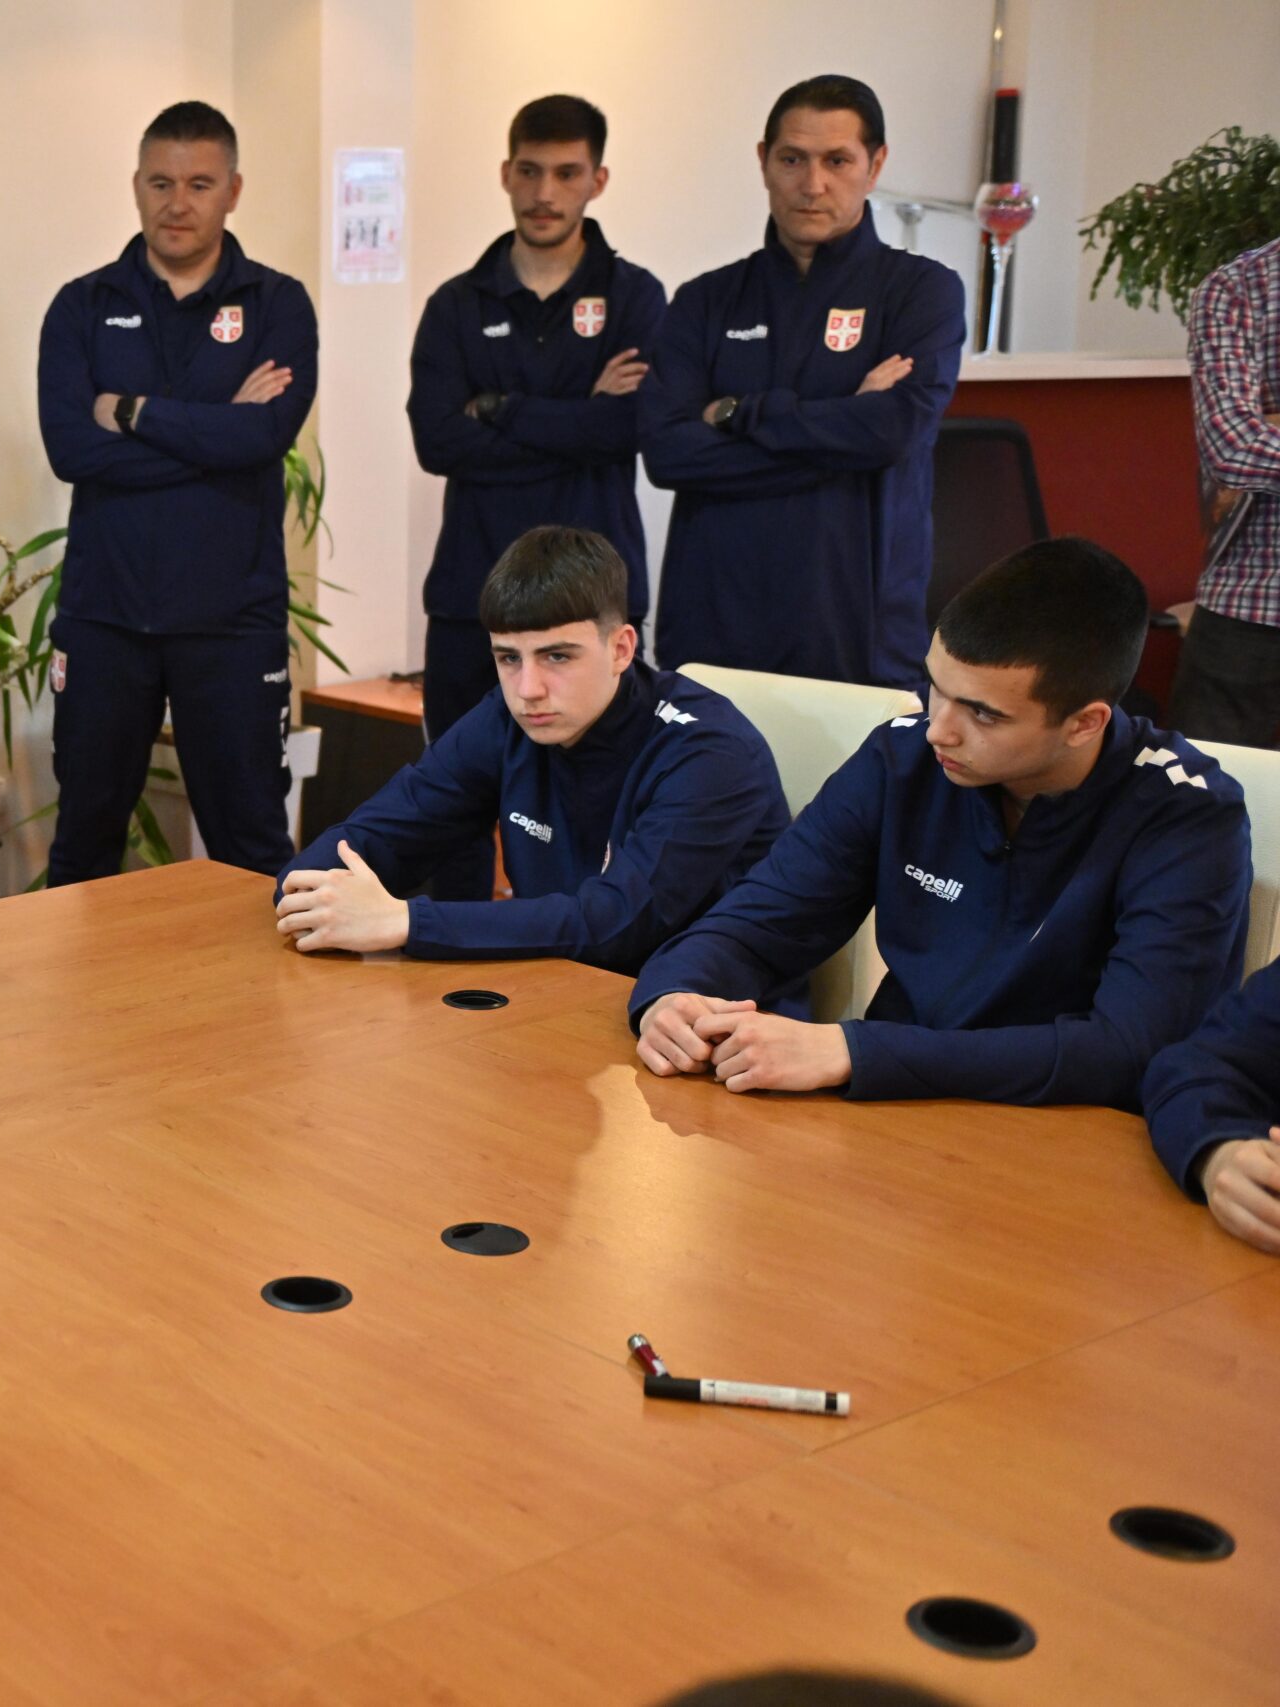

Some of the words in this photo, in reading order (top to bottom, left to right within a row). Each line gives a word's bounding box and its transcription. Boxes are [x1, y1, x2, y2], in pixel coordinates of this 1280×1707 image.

[509, 811, 552, 840] capelli
[904, 864, 964, 898] capelli
[924, 884, 957, 903] SPORT
